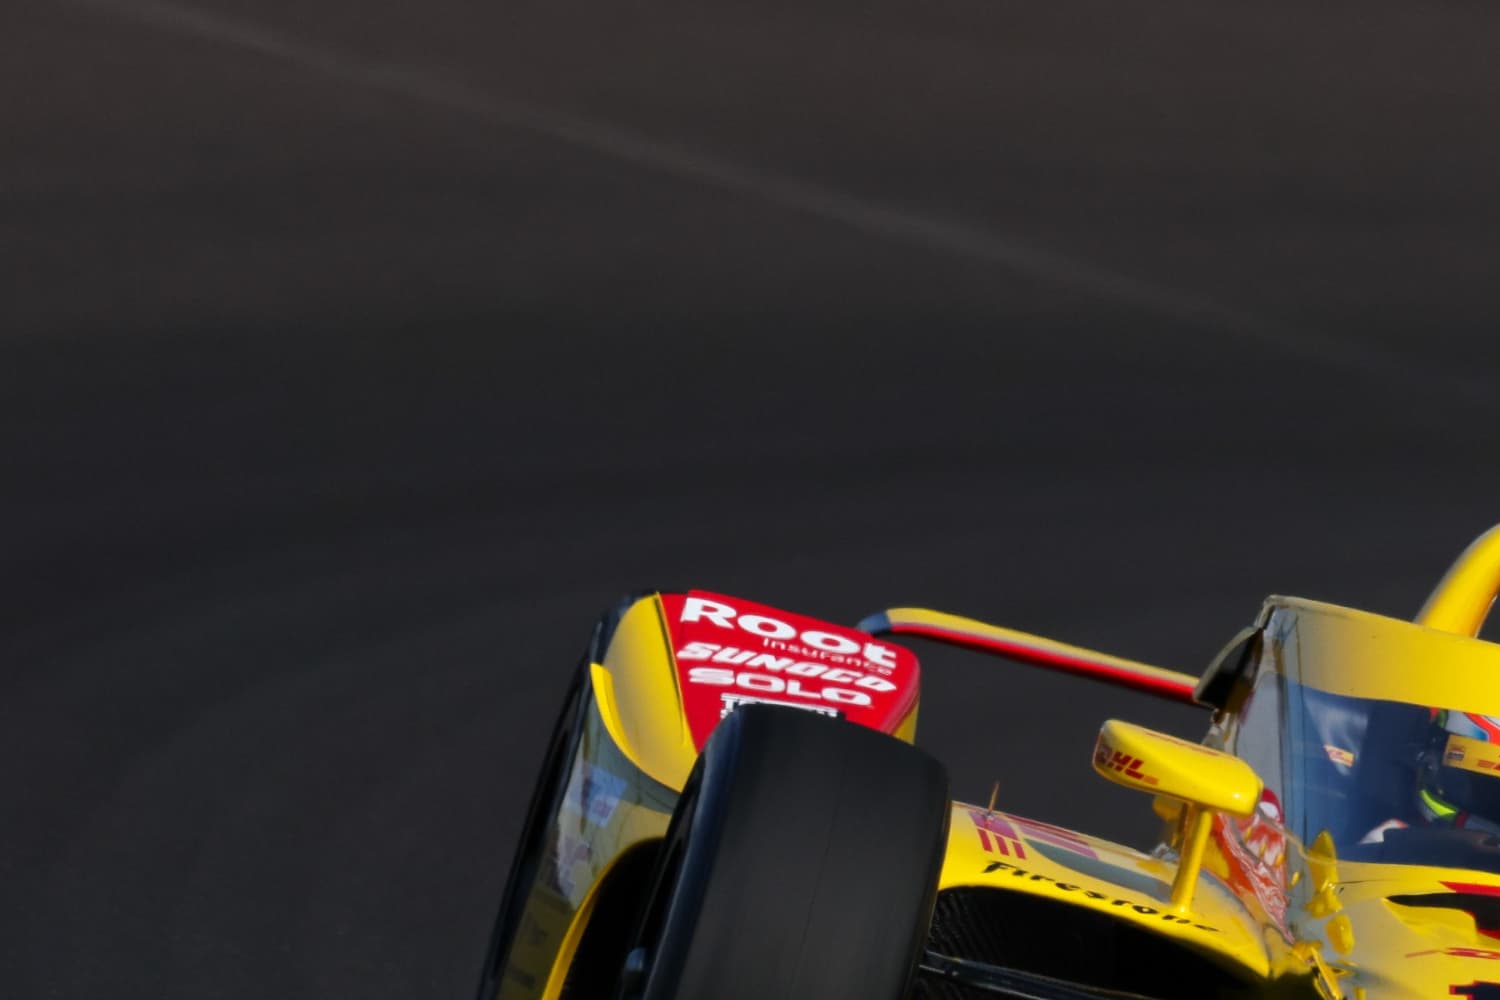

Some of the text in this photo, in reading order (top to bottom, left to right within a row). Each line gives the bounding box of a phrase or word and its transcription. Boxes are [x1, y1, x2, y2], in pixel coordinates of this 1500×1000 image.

[680, 597, 897, 670] Root
[677, 641, 897, 692] SUNOCO
[688, 667, 872, 706] SOLO
